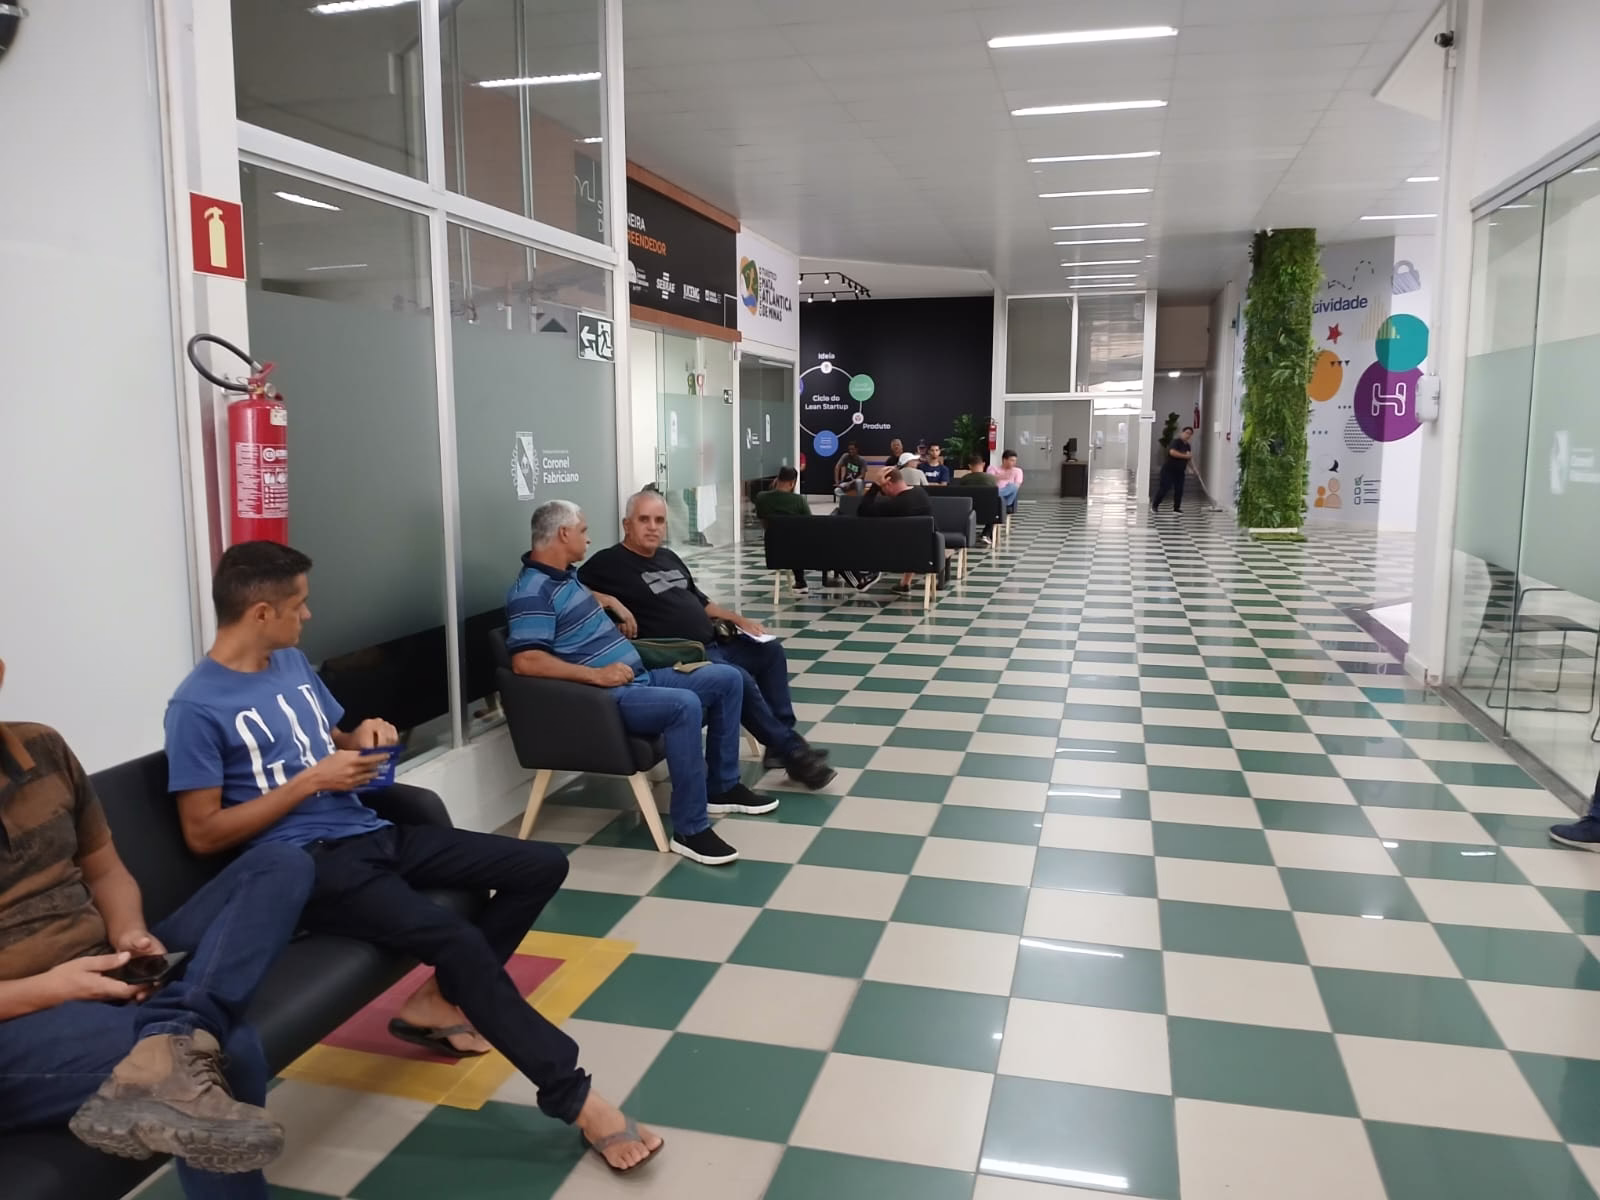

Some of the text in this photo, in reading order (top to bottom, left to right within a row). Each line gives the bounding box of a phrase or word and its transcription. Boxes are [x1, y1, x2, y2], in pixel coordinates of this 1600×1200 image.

[812, 394, 830, 402] Ciclo
[822, 403, 849, 411] Startup
[542, 456, 570, 469] Coronel
[543, 471, 579, 484] Fabriciano
